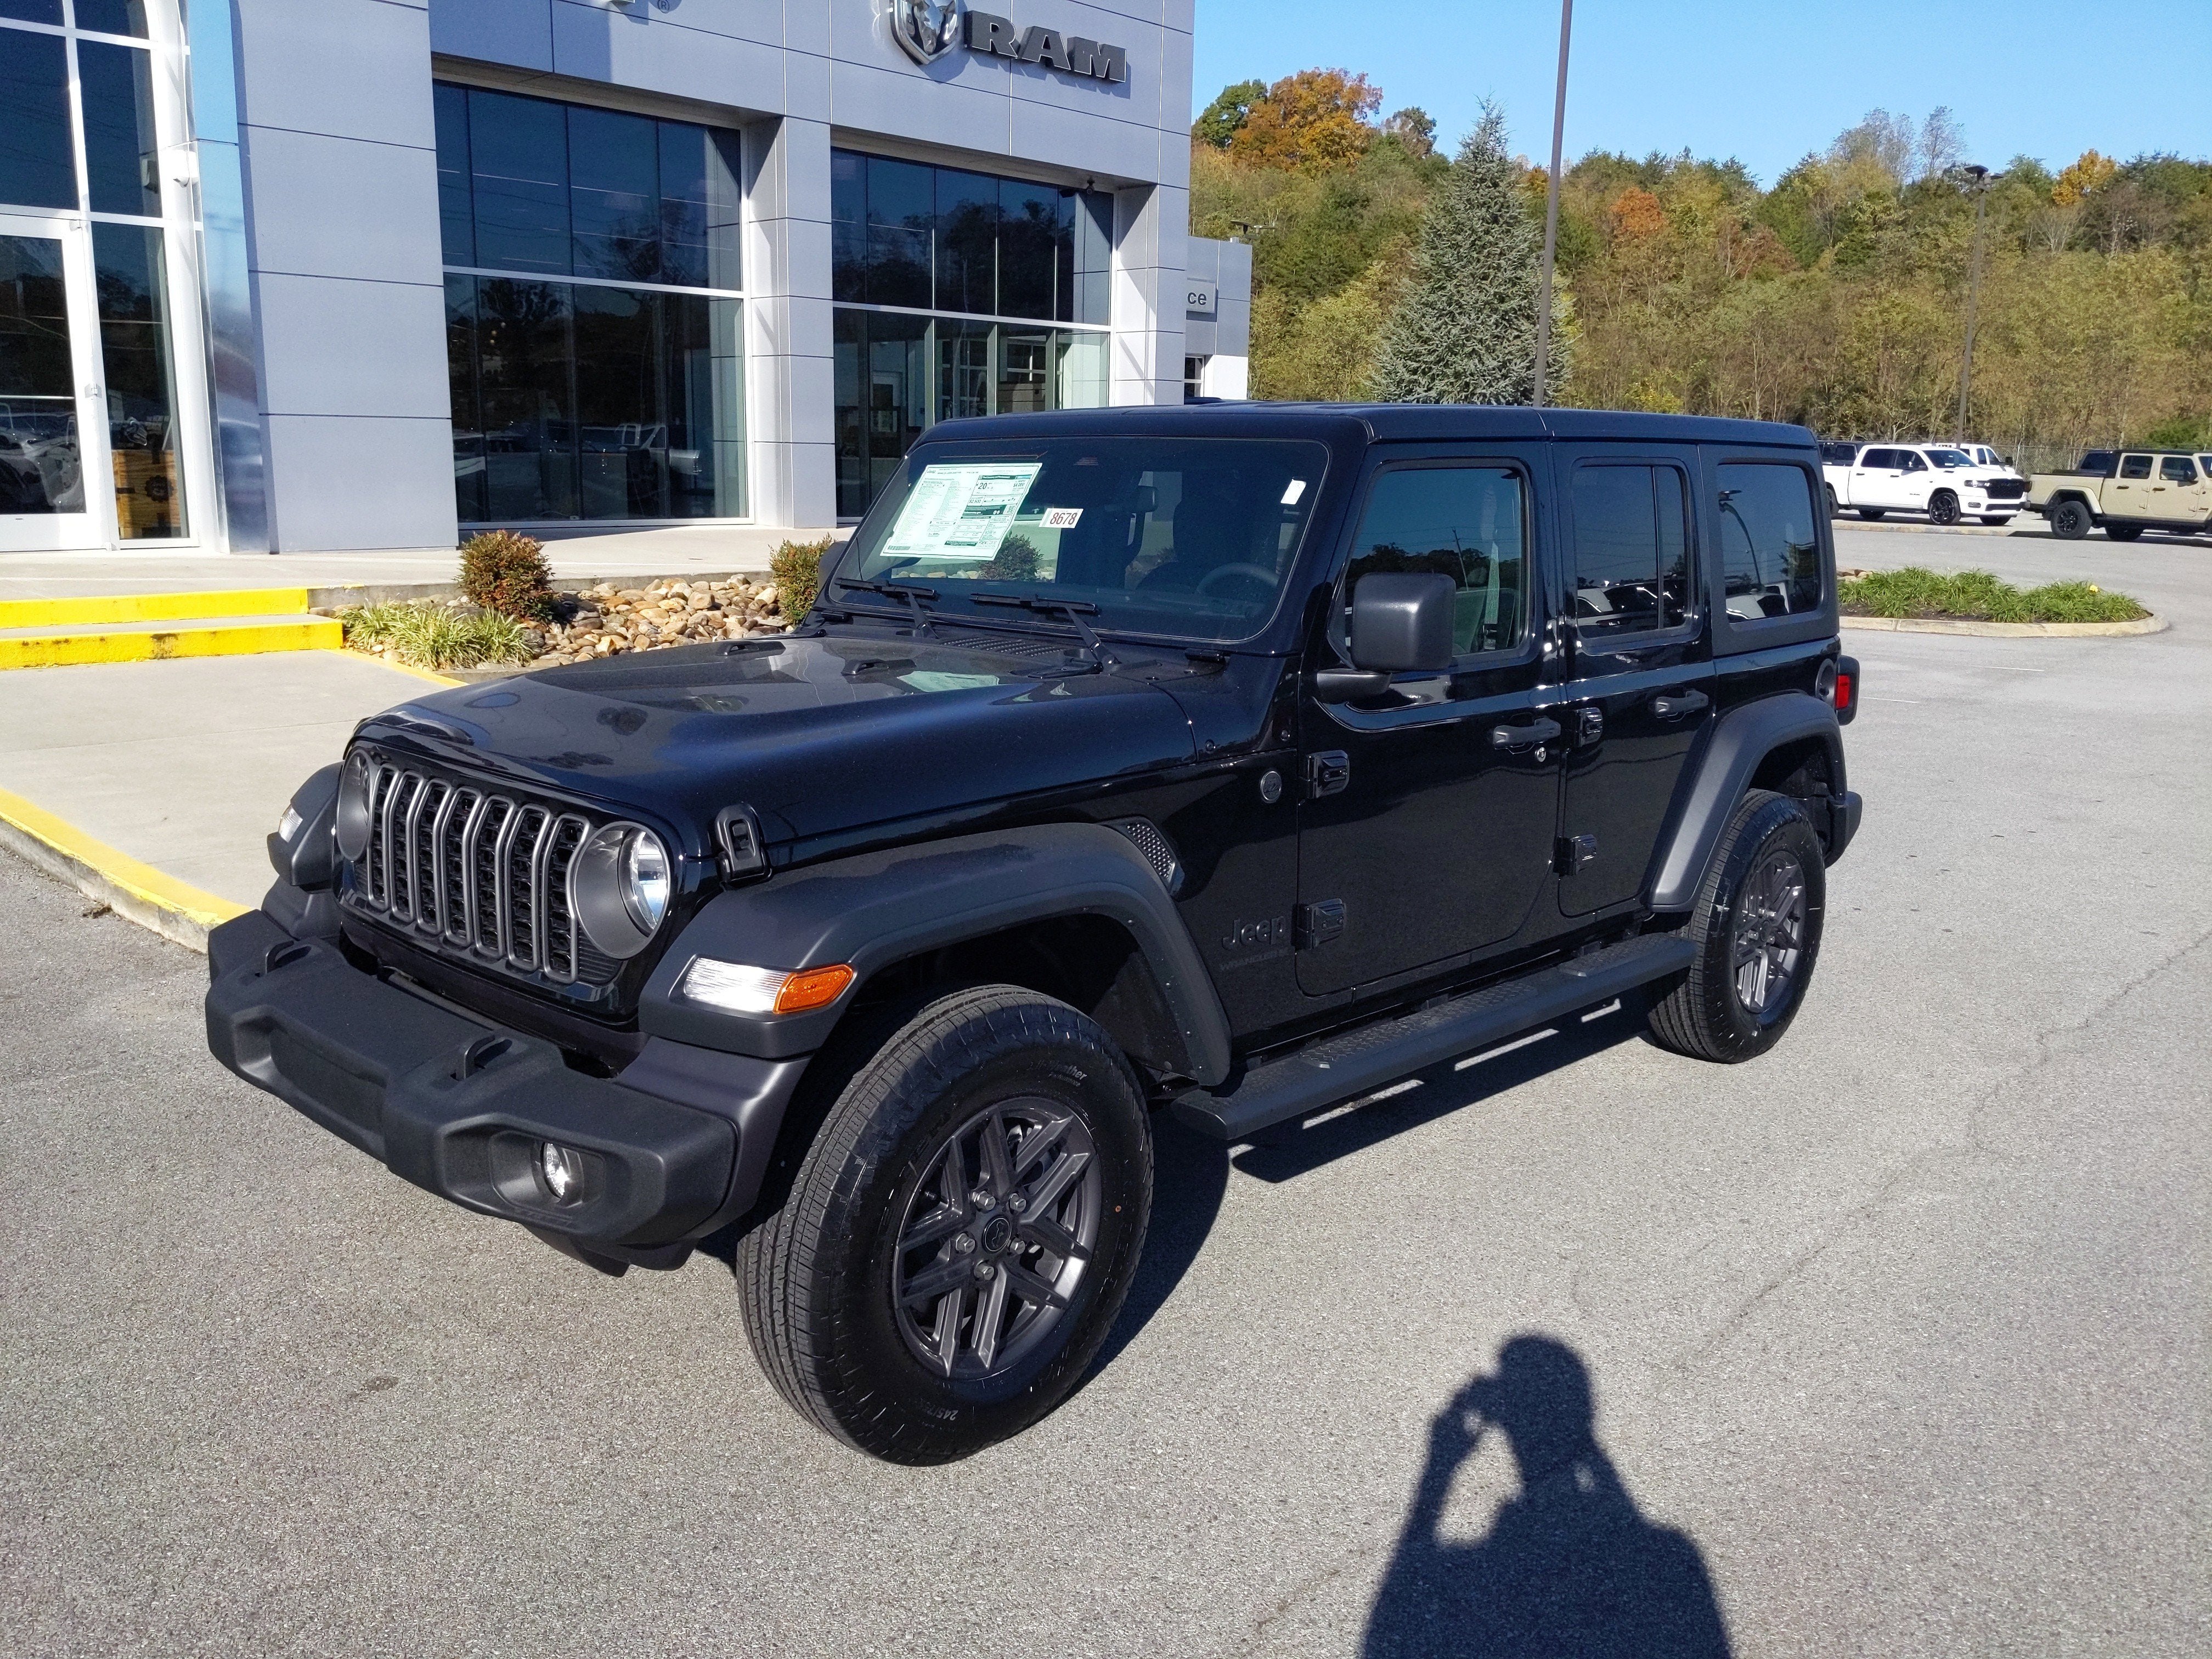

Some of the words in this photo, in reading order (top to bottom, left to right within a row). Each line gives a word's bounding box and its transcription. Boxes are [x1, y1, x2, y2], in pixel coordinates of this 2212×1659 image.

[964, 10, 1127, 83] RAM
[1049, 512, 1078, 525] 8678
[1222, 915, 1285, 950] Jeep
